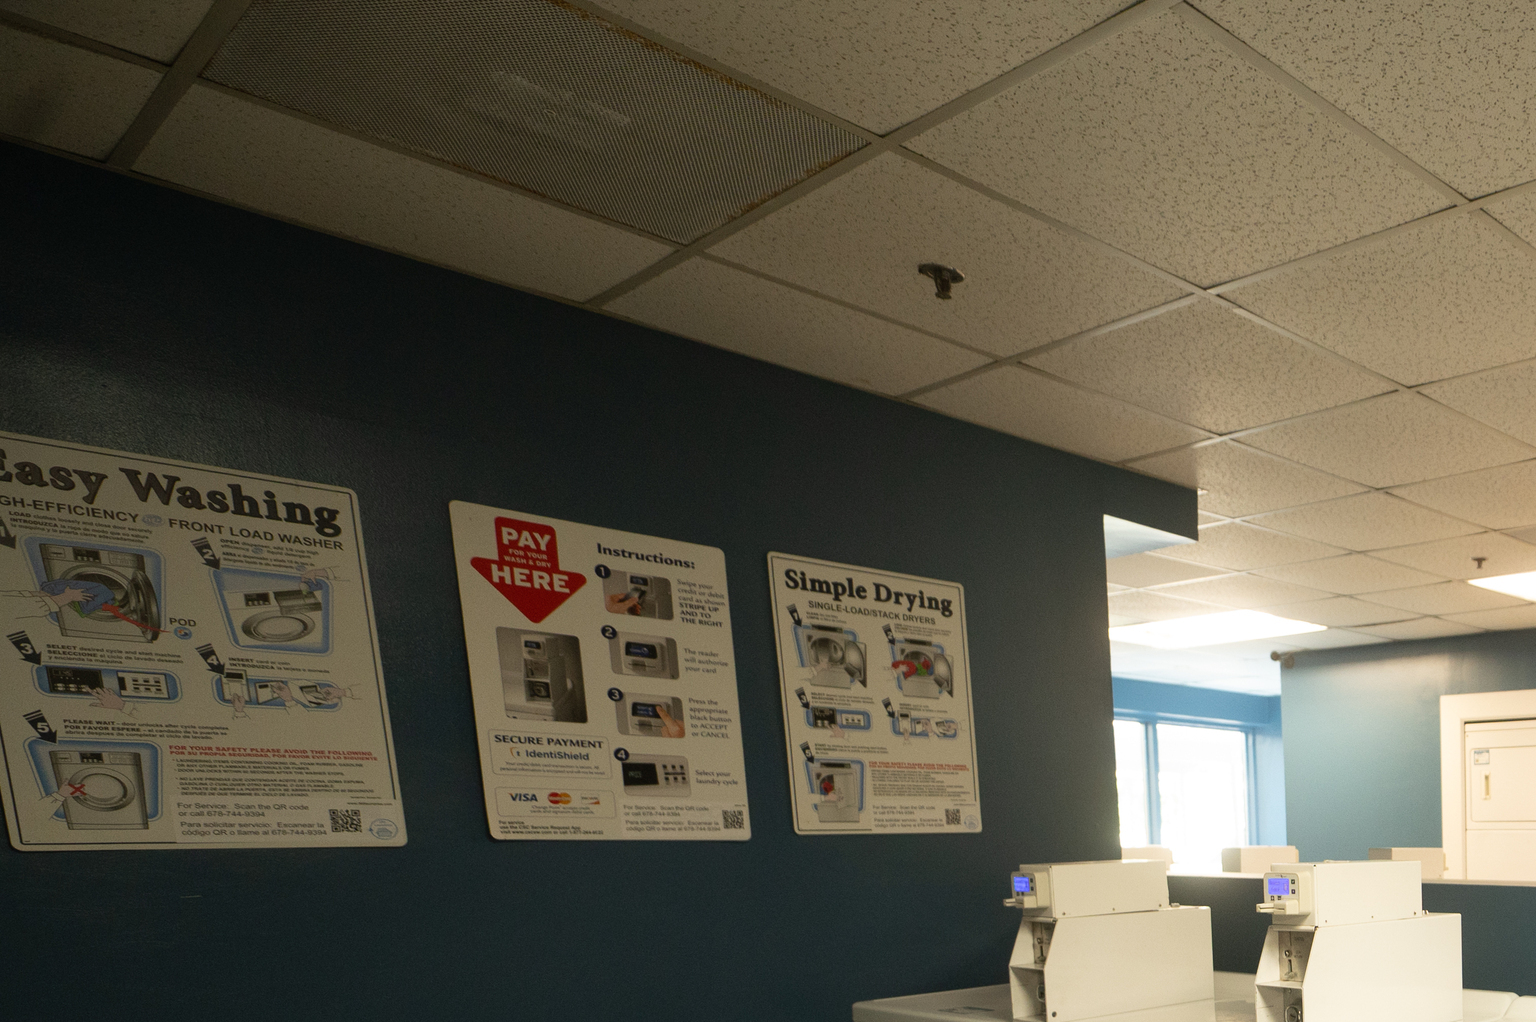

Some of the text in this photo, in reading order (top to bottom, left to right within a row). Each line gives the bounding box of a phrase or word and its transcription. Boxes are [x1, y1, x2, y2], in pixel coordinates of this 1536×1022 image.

[119, 467, 342, 538] Washing
[10, 517, 58, 528] INTRODUZCA
[168, 518, 225, 535] FRONT
[229, 526, 274, 541] LOAD
[277, 533, 344, 551] WASHER
[501, 526, 551, 551] PAY
[202, 548, 214, 559] 2
[508, 548, 548, 560] FOR YOUR
[597, 542, 695, 569] Instructions:
[503, 555, 527, 565] WASH
[536, 561, 552, 569] DRY
[600, 567, 605, 577] 1
[490, 563, 570, 594] HERE
[676, 579, 697, 590] Swipe
[677, 587, 697, 596] credit
[707, 591, 725, 599] debit
[784, 568, 953, 618] Simple Drying
[678, 595, 694, 603] card
[704, 598, 726, 607] shown
[679, 602, 719, 613] STRIPE UP
[680, 609, 698, 617] AND
[808, 600, 901, 621] SINGLE-LOAD/STACK
[902, 613, 936, 625] DRYERS
[169, 617, 196, 627] POD
[680, 617, 723, 628] THE RIGHT
[605, 627, 613, 638] 2
[20, 643, 33, 655] 3
[684, 647, 719, 657] The reader
[206, 655, 219, 666] 4
[698, 658, 729, 667] authorize
[611, 689, 620, 700] 3
[688, 697, 718, 706] Press the
[689, 706, 728, 715] appropriate
[690, 714, 732, 723] black button
[37, 722, 48, 733] 5
[700, 723, 728, 731] ACCEPT
[700, 731, 730, 739] CANCEL
[494, 734, 604, 749] SECURE PAYMENT
[526, 749, 590, 761] IdentiShield
[617, 749, 626, 760] 4
[695, 769, 715, 777] Select
[696, 777, 721, 786] laundry
[508, 792, 538, 802] VISA
[273, 803, 287, 811] QR
[207, 810, 265, 818] 678-744-9394
[277, 821, 315, 829] Escanear
